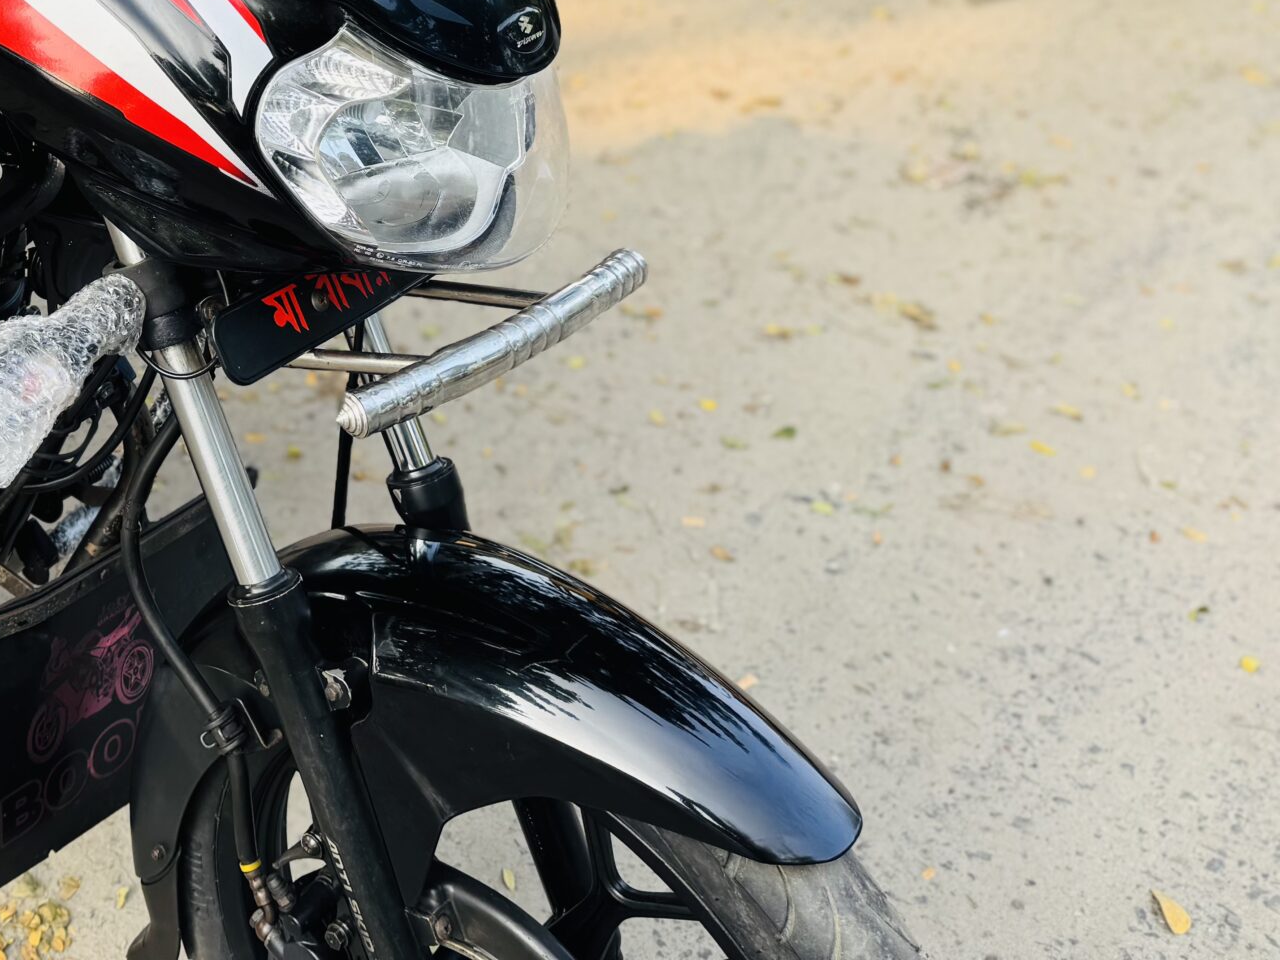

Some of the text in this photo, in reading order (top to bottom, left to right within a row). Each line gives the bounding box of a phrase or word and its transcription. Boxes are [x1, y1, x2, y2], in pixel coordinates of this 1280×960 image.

[261, 283, 310, 334] মা
[325, 835, 375, 953] ANTI SKID
